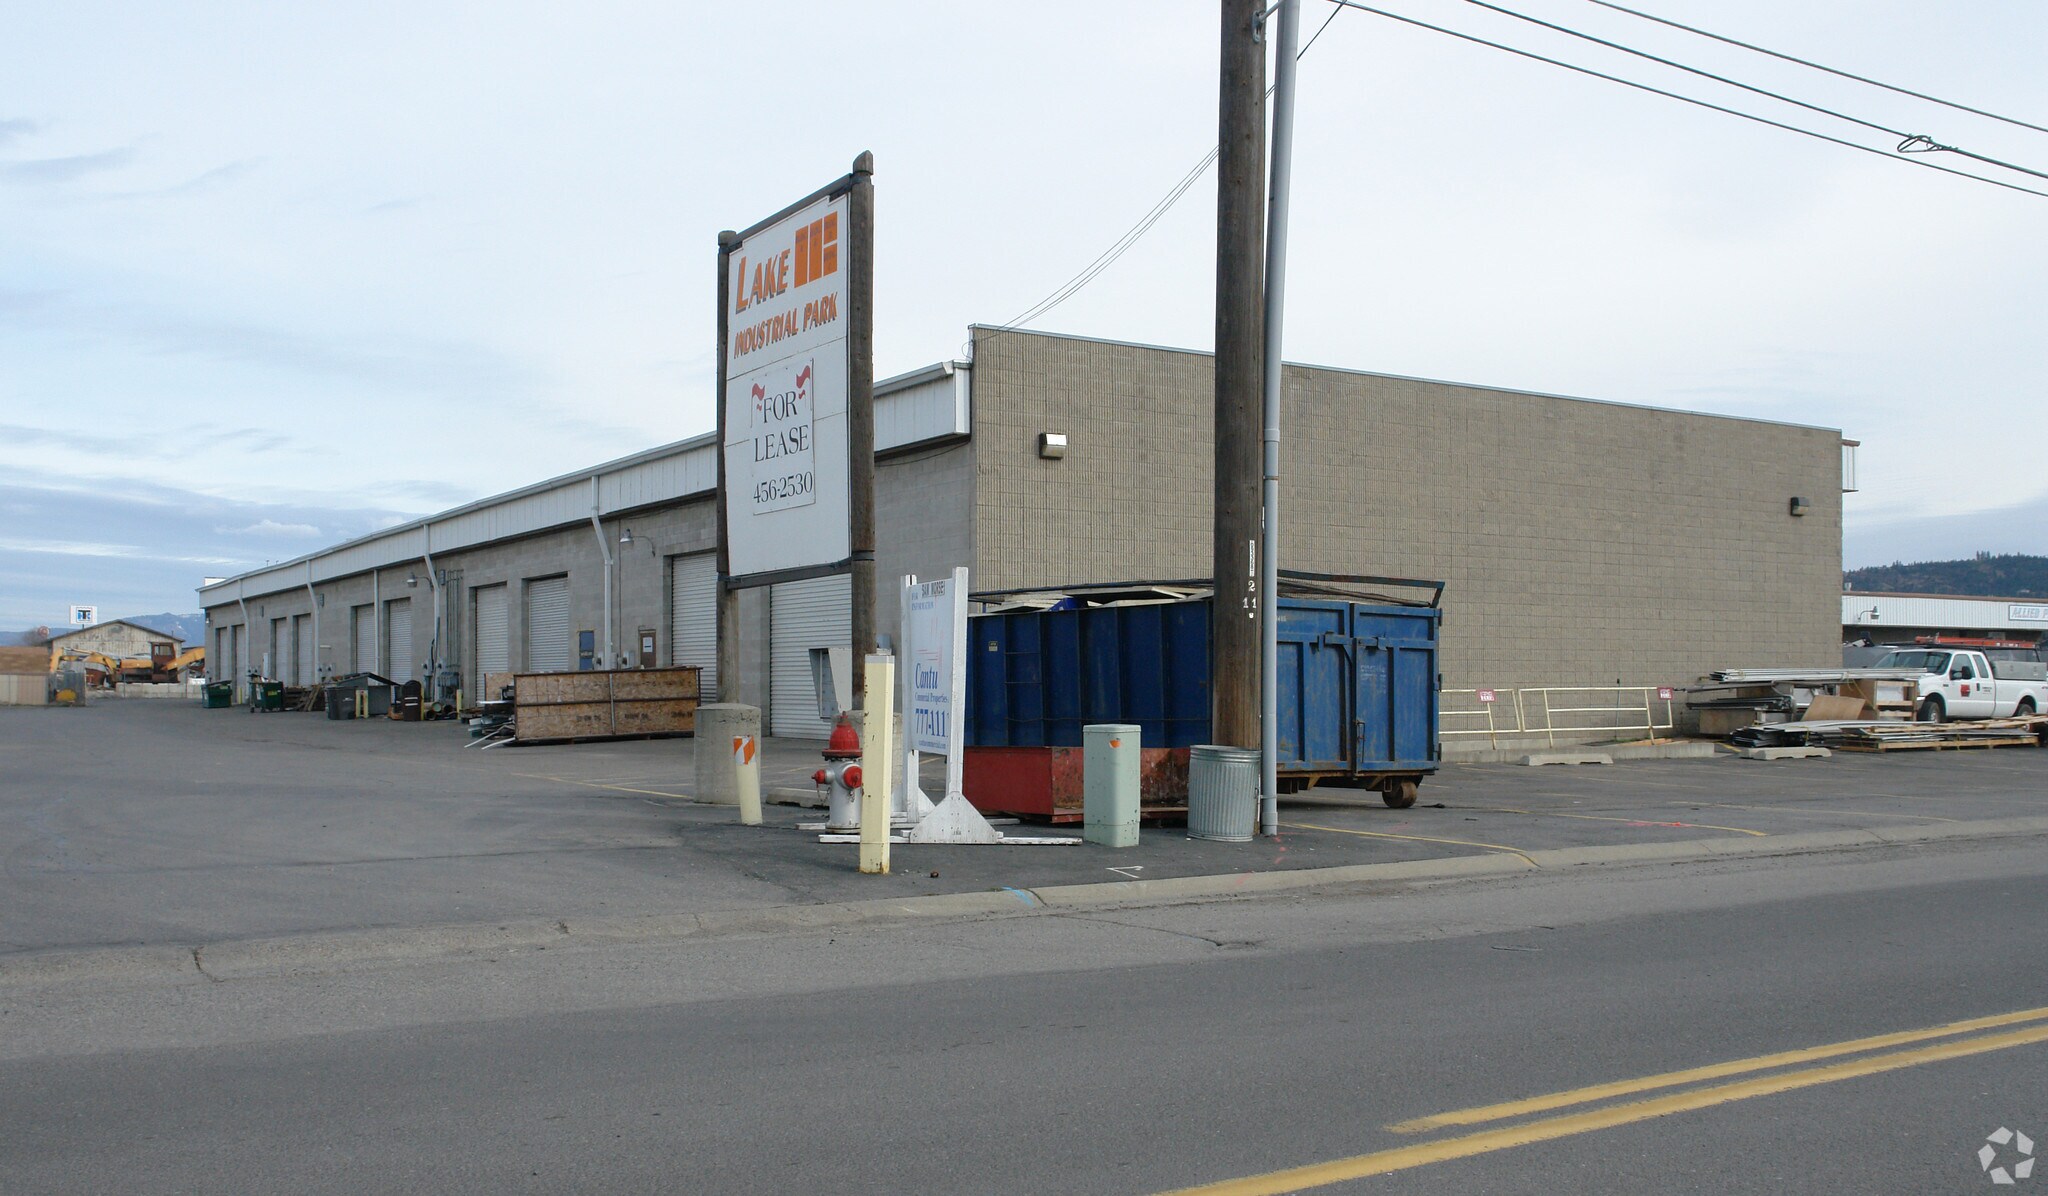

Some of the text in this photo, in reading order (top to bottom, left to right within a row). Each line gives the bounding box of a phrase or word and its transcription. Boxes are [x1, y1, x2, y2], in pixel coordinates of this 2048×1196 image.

[735, 248, 791, 315] LAKE
[733, 291, 838, 360] INDUSTRIAL PARK
[763, 391, 798, 424] FOR
[754, 424, 809, 462] LEASE
[753, 471, 813, 503] 456-2530
[1248, 580, 1256, 592] 2
[915, 662, 938, 690] Cantu
[915, 707, 949, 738] 777-111
